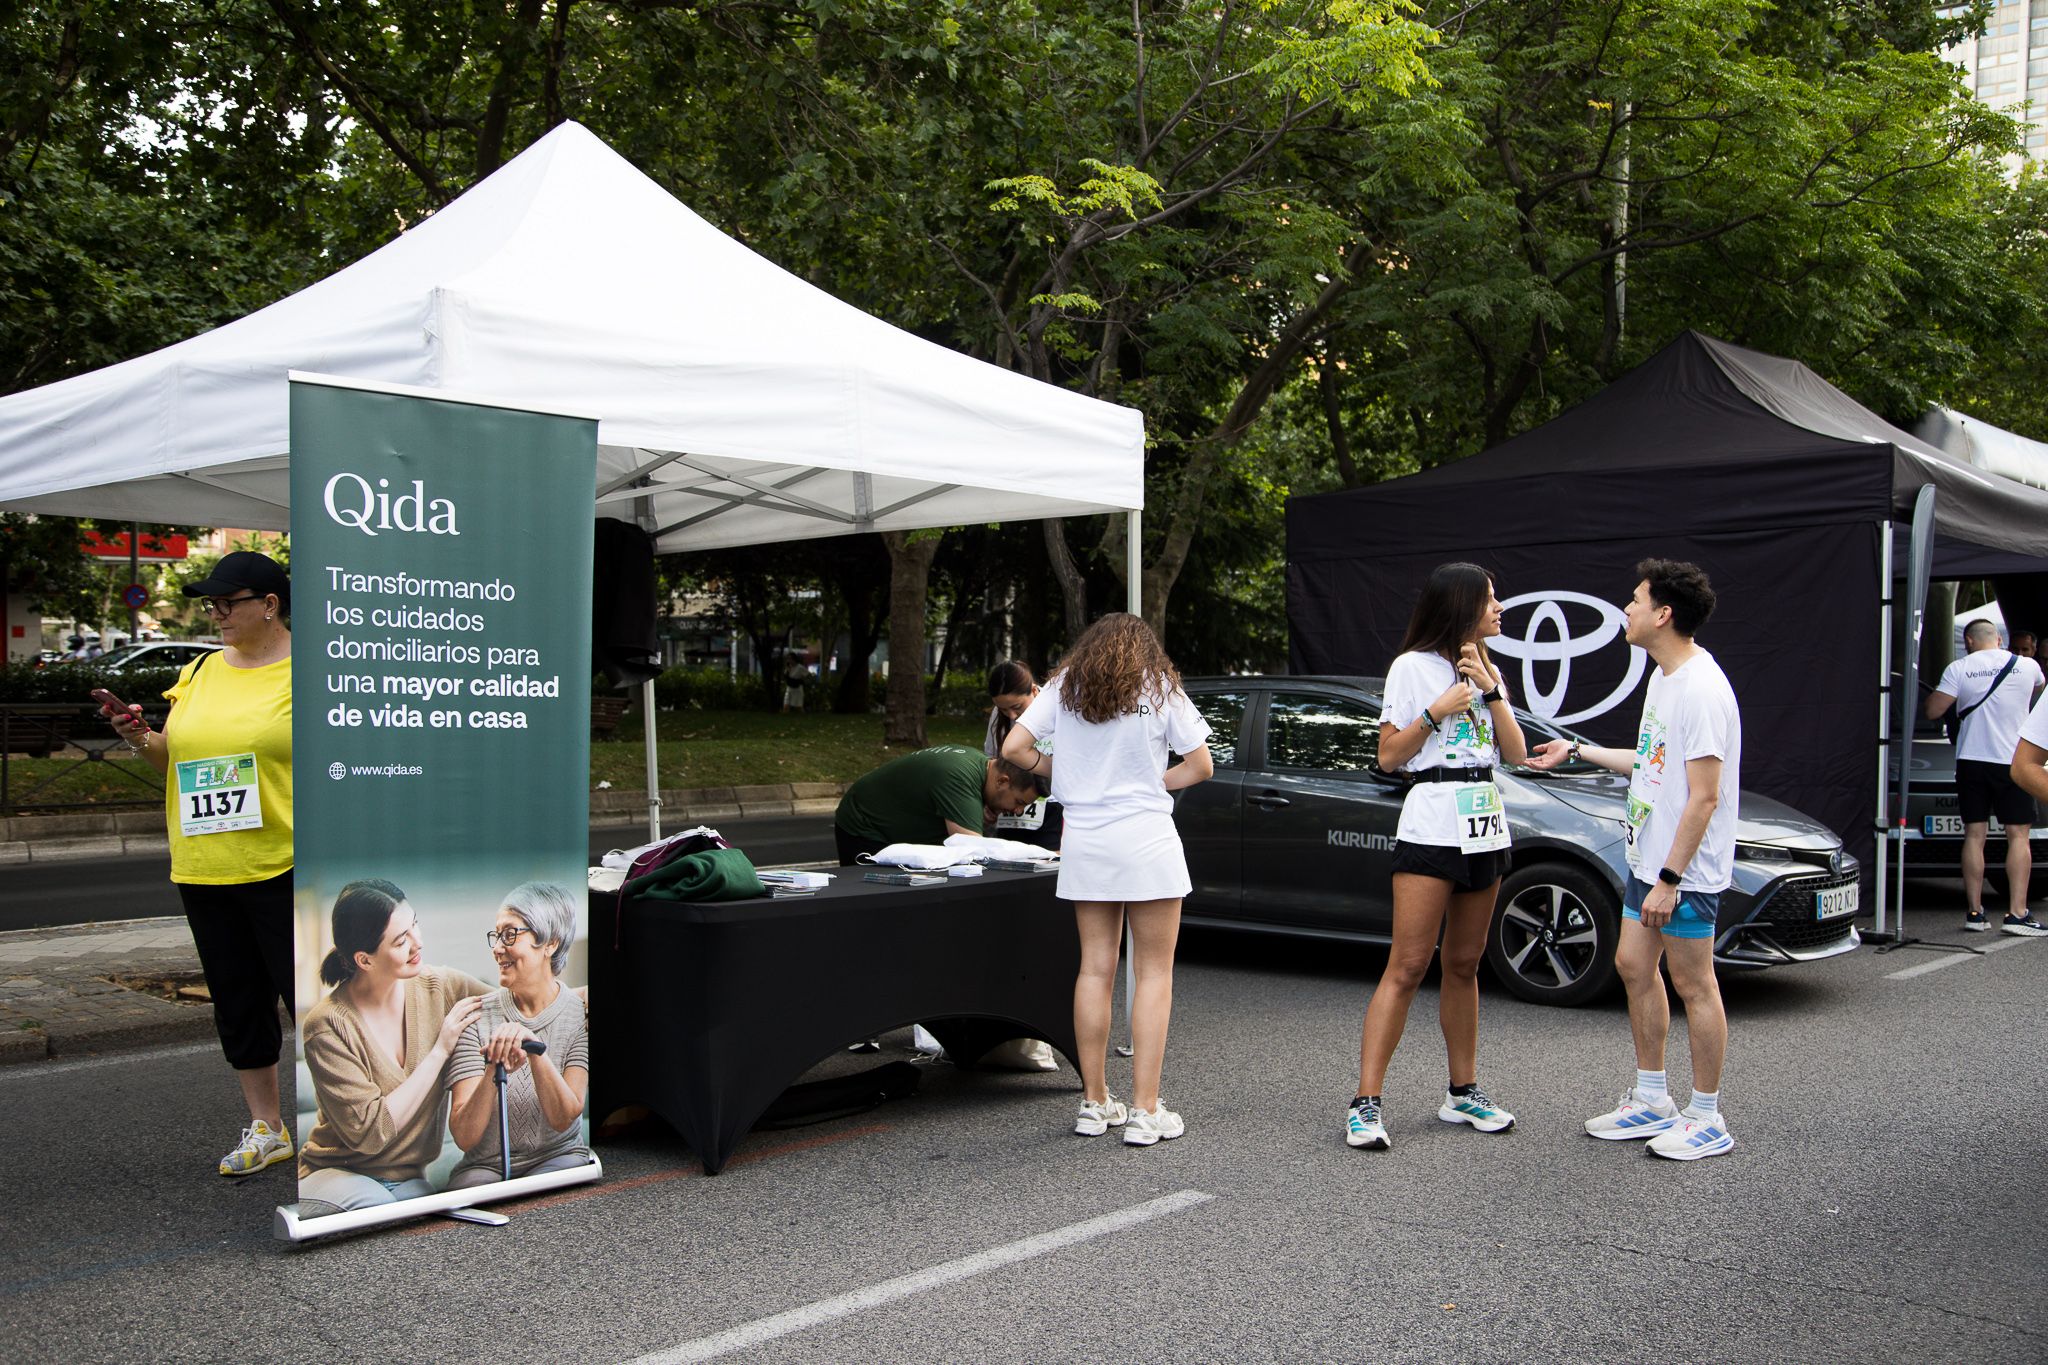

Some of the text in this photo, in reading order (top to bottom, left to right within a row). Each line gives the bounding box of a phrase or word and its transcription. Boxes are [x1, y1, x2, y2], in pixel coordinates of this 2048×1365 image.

[324, 472, 460, 536] Qida
[326, 566, 516, 602] Transformando
[326, 600, 485, 632] los cuidados
[326, 635, 540, 670] domiciliarios para
[327, 673, 559, 700] una mayor calidad
[327, 702, 528, 729] de vida en casa
[195, 763, 240, 788] ELA
[351, 763, 423, 777] www.qida.es
[191, 789, 247, 818] 1137
[1935, 818, 1966, 832] 515
[1823, 892, 1843, 914] 9212
